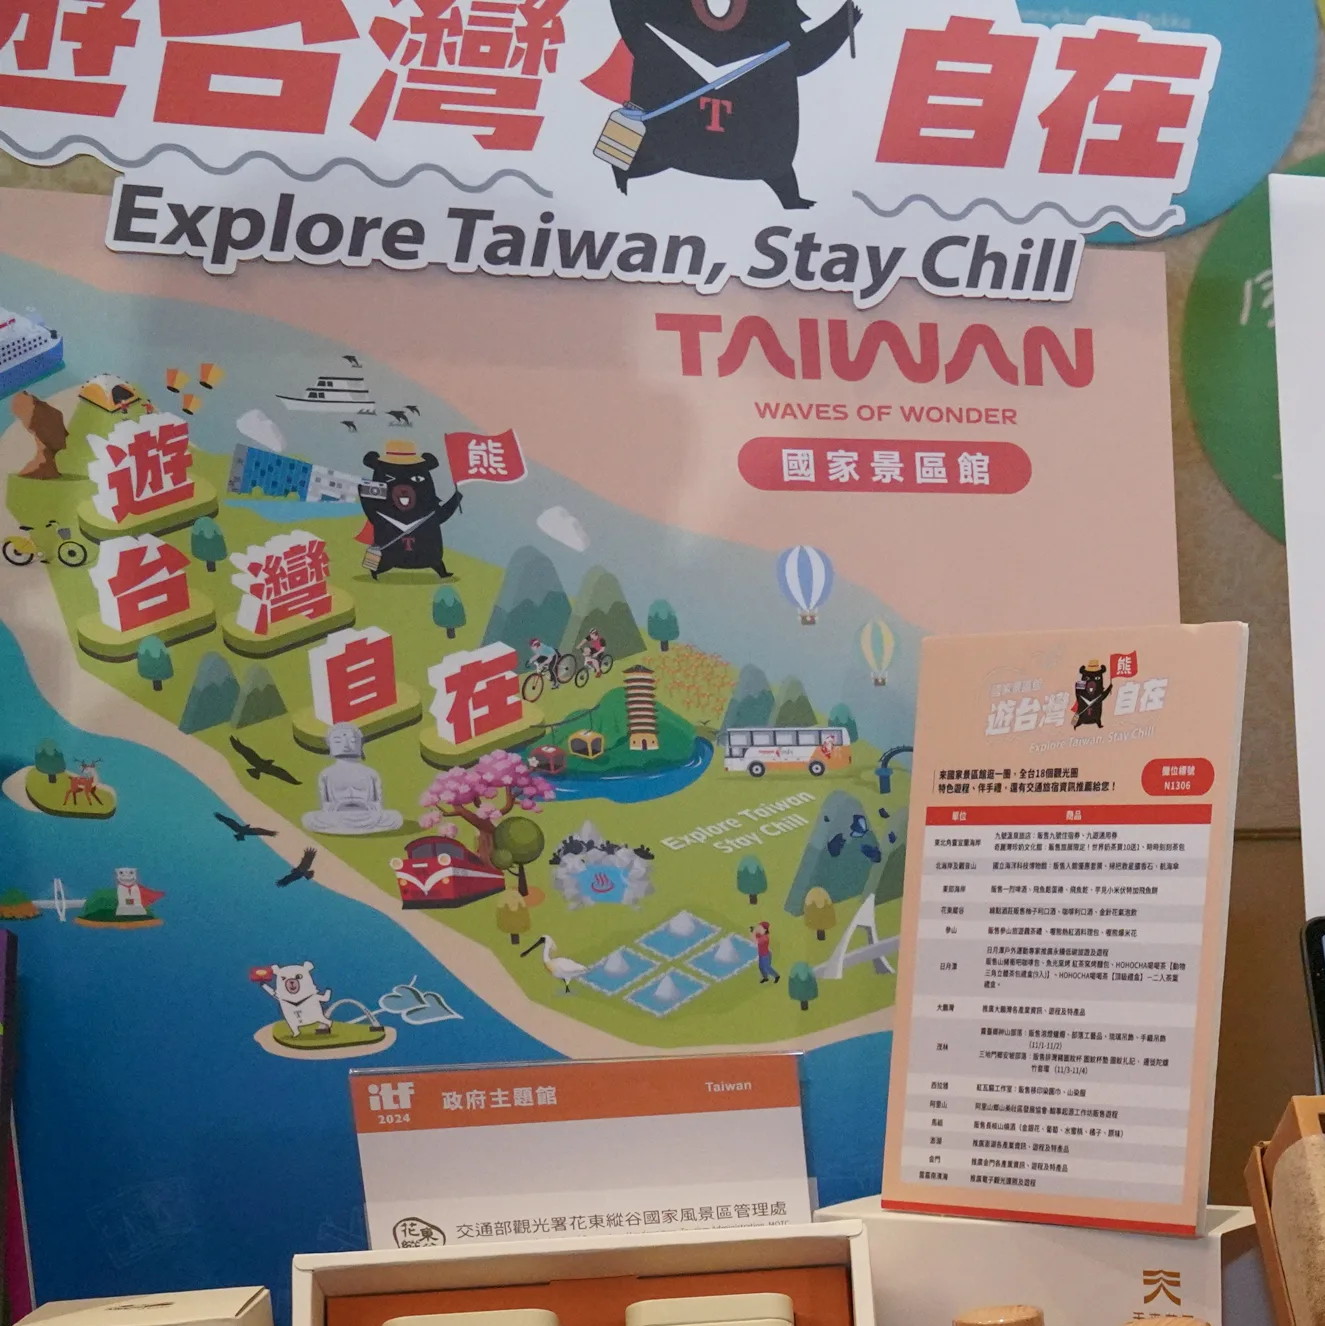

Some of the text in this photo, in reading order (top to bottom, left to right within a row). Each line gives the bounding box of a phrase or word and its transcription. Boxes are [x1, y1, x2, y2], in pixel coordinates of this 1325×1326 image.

[875, 15, 1208, 179] 自在
[111, 184, 1079, 300] Explore Taiwan, Stay Chill
[655, 313, 1096, 388] TAIWAN
[754, 401, 1018, 426] WAVES OF WONDER
[107, 422, 196, 524] 遊
[467, 440, 507, 478] 熊
[781, 448, 991, 487] 國家景區館
[985, 678, 1170, 737] 遊台灣 自在
[1163, 781, 1191, 791] N1306
[661, 789, 816, 854] Explore Taiwan
[714, 812, 809, 857] Stay Chill
[1065, 809, 1082, 821] 商品
[368, 1080, 416, 1112] itf
[441, 1085, 558, 1113] 政府主題館
[704, 1079, 752, 1095] Taiwan
[377, 1112, 412, 1126] 2024
[456, 1200, 788, 1240] 交通部觀光署花東縱谷國家風景區管理處
